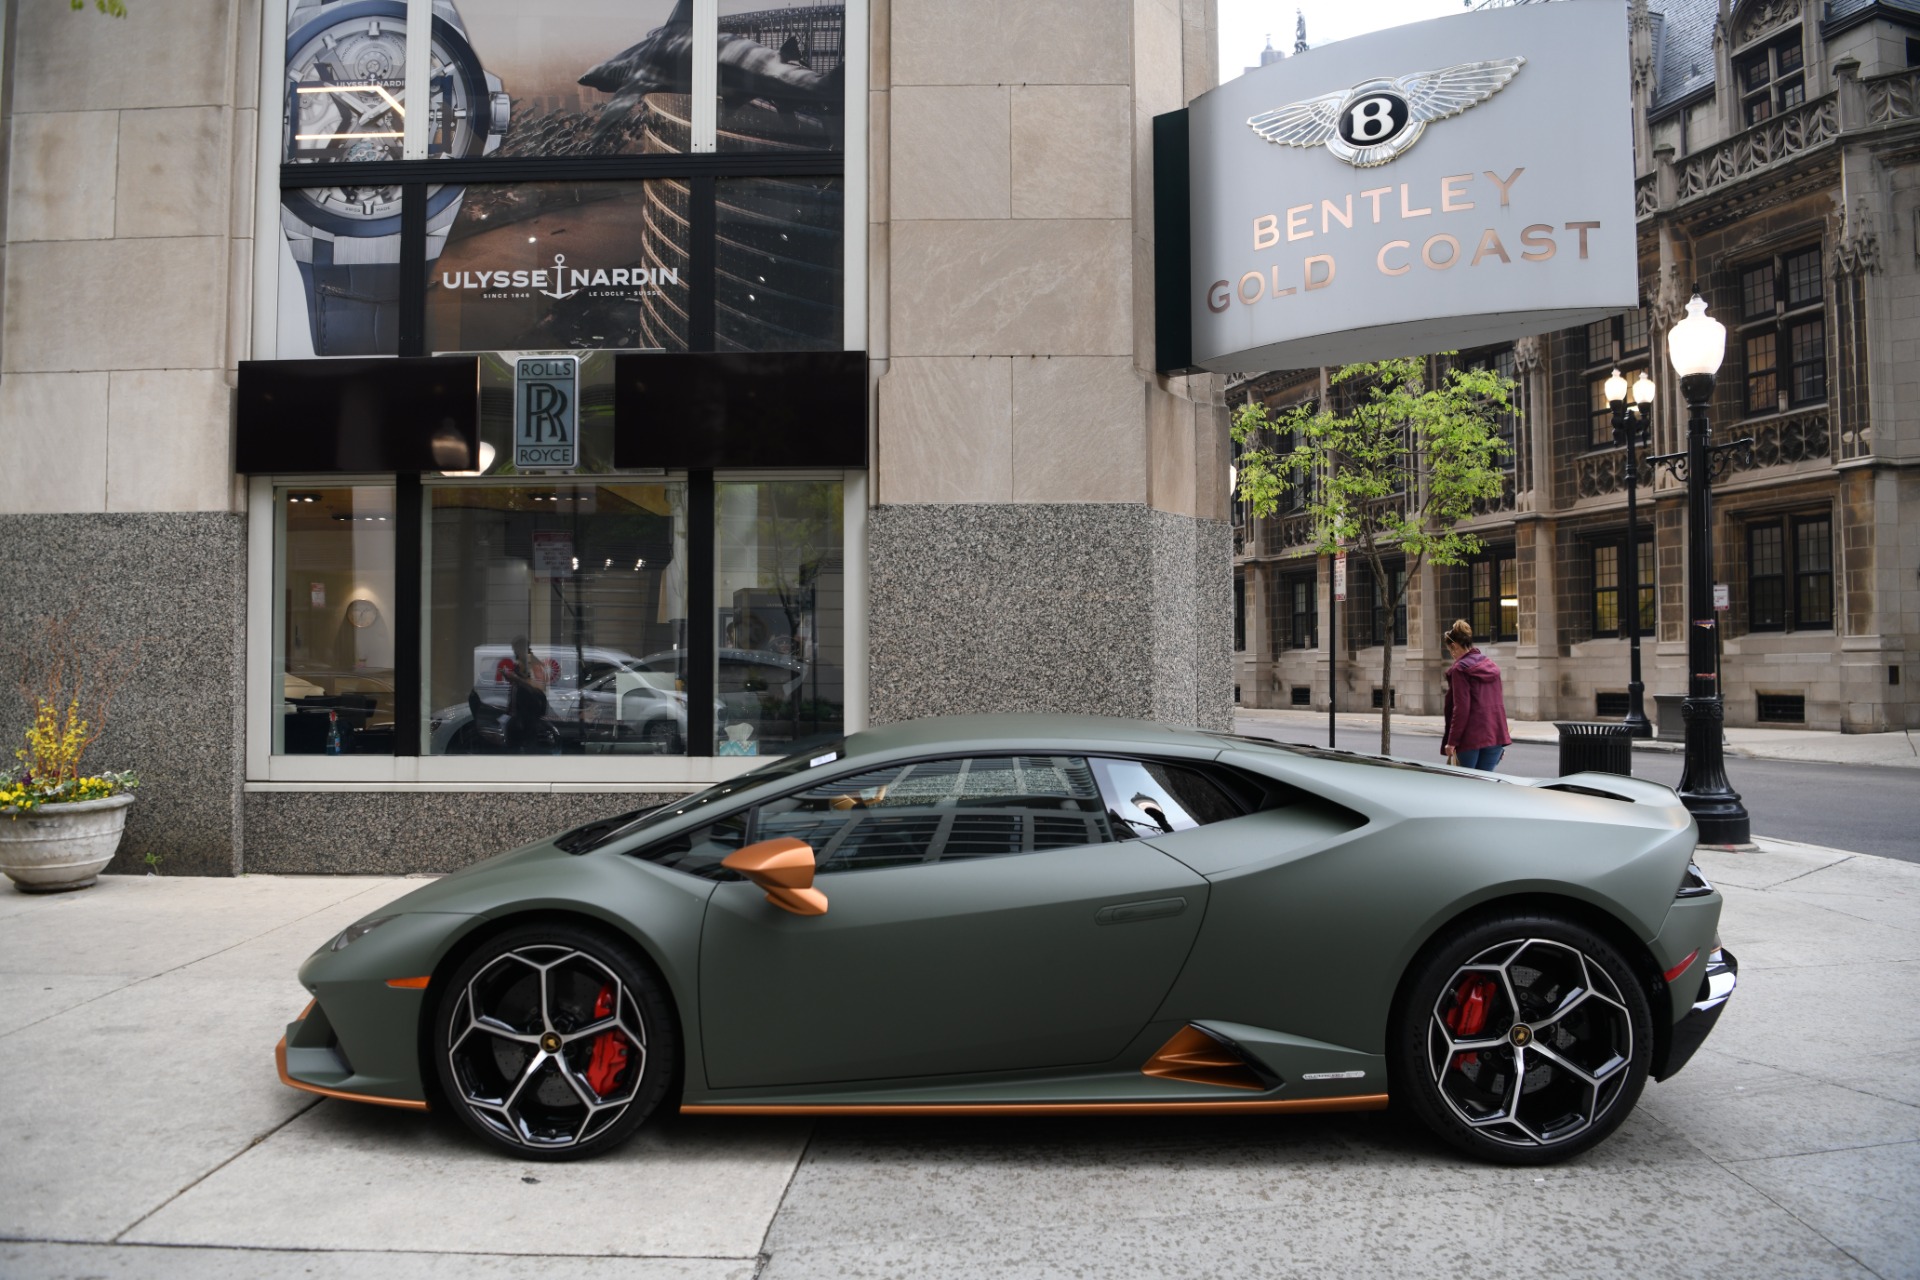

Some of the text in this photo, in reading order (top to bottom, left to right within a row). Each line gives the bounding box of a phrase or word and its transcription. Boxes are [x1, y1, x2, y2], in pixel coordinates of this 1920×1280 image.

[1350, 97, 1395, 142] B
[1252, 166, 1526, 252] BENTLEY
[442, 267, 678, 289] ULYSSE NARDIN
[1206, 220, 1601, 314] GOLD COAST
[521, 363, 571, 376] ROLLS
[520, 449, 570, 462] ROYCE
